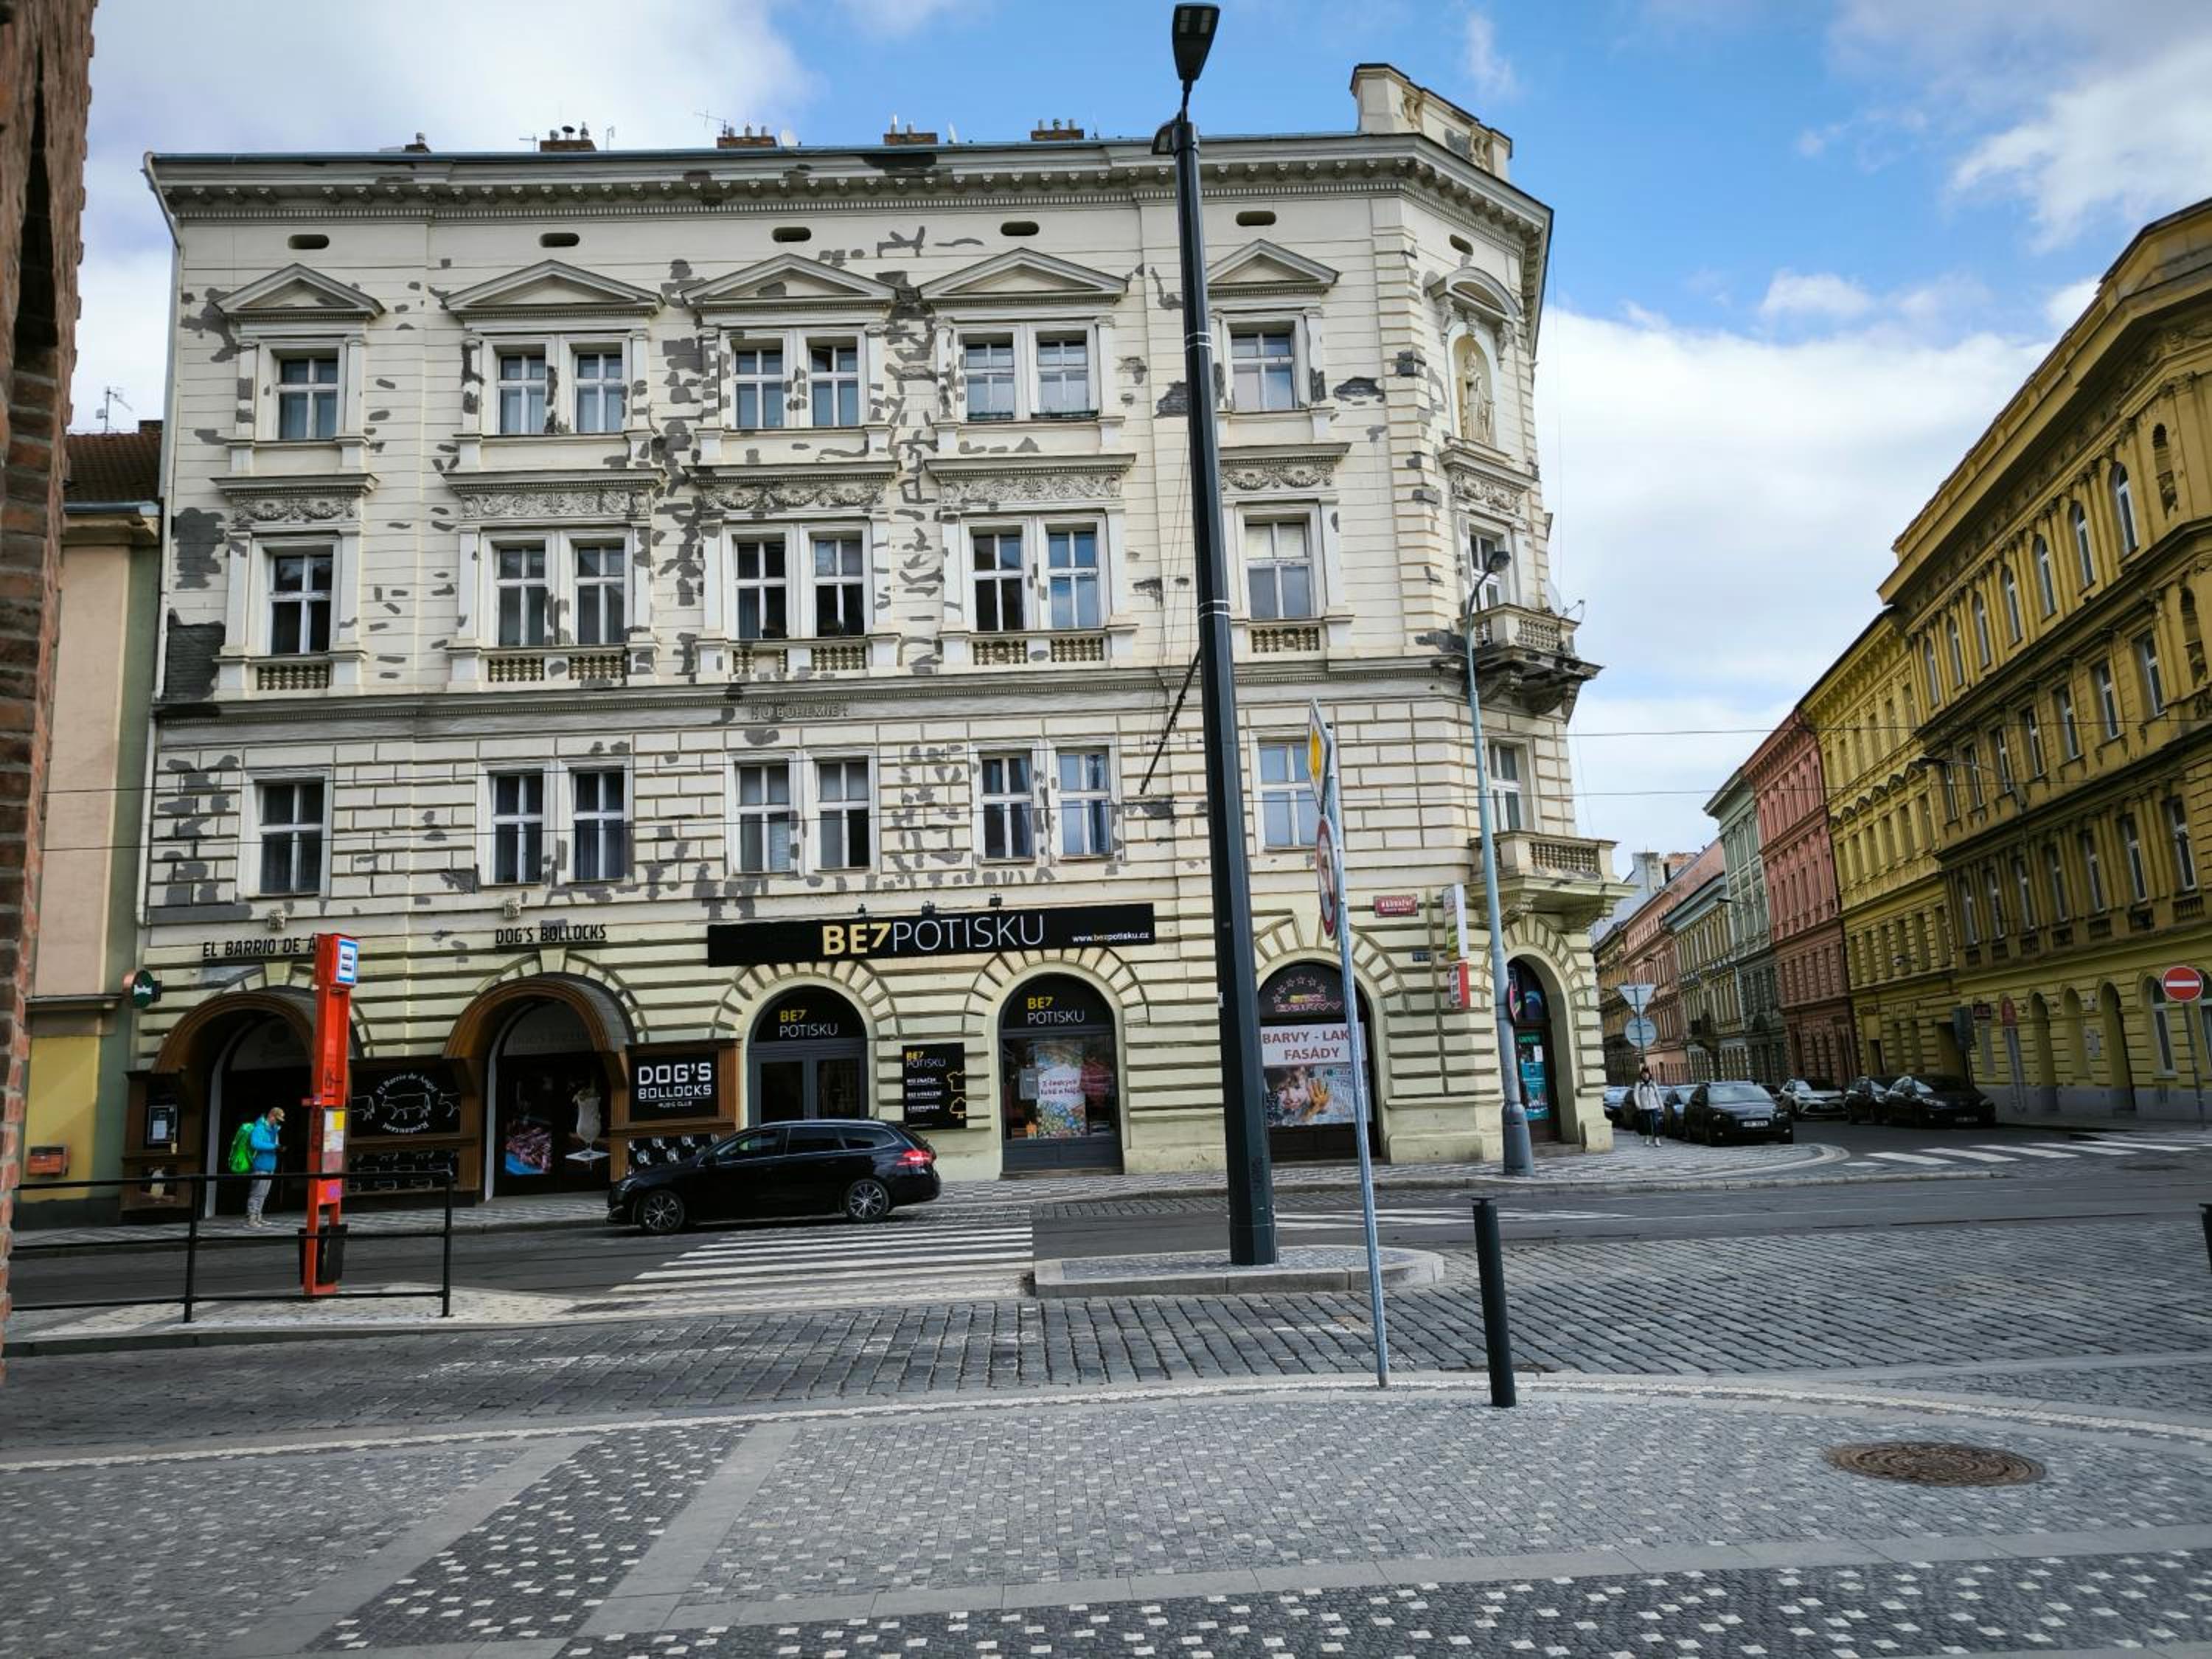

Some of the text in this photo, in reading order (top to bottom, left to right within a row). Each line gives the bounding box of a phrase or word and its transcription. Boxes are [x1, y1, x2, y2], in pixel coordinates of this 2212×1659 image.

[495, 924, 607, 944] DOG'S BOLLOCKS
[1072, 932, 1150, 942] www.bezpotisku.cz
[203, 941, 217, 957] EL
[225, 938, 276, 956] BARRIO
[283, 936, 300, 953] DE
[1027, 1009, 1085, 1025] POTISKU
[779, 1023, 838, 1037] POTISKU
[1262, 1032, 1310, 1044] BARVY
[1284, 1046, 1339, 1060] FASÁDY
[906, 1057, 946, 1068] POTISKU
[639, 1062, 712, 1085] DOG'S
[639, 1084, 712, 1099] BOLLOCKS
